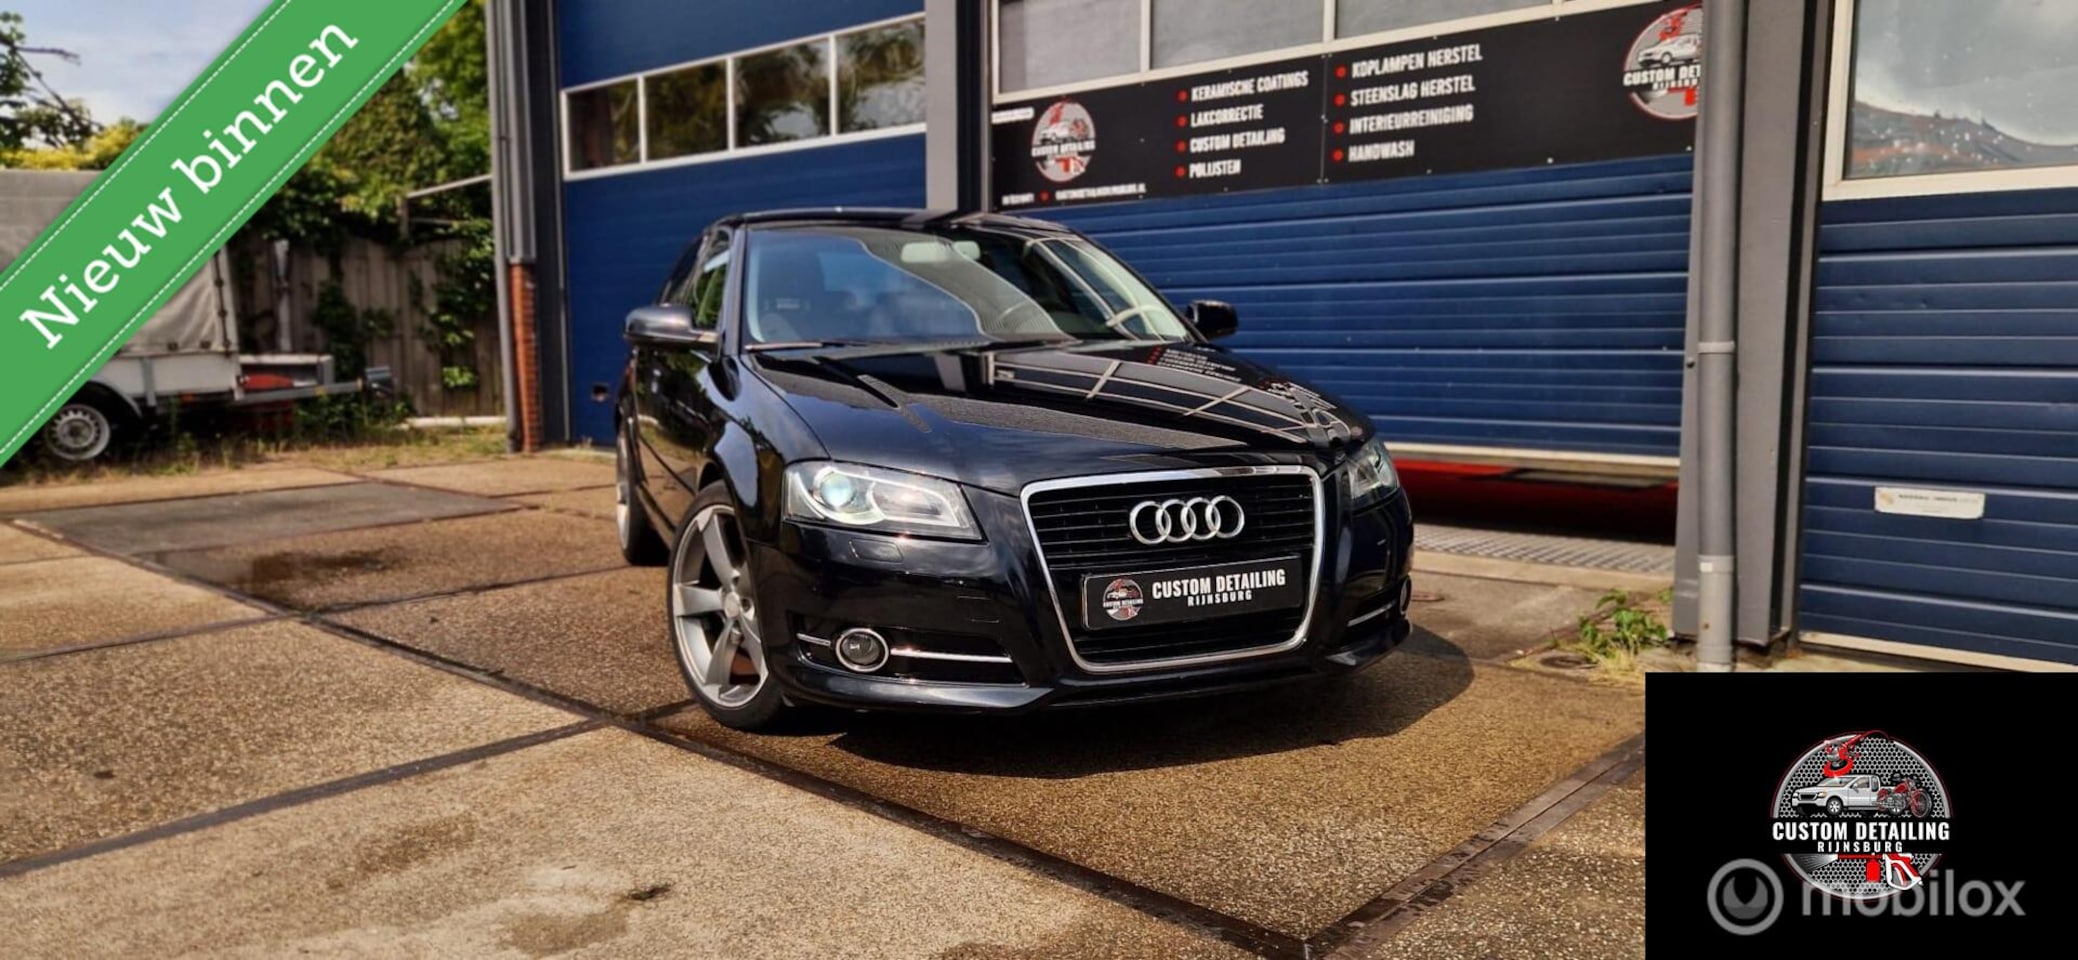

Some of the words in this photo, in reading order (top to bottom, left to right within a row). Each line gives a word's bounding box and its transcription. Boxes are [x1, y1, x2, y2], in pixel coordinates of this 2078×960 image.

[1351, 52, 1425, 78] KOPLAMPEN
[1427, 43, 1483, 68] HERSTEL
[1191, 78, 1255, 102] KERAMISCHE
[1256, 70, 1309, 92] COATINGS
[1623, 67, 1676, 87] CUSTOM
[1679, 64, 1701, 80] DET
[1350, 82, 1418, 107] STEENSLAG
[1420, 74, 1476, 98] HERSTEL
[1190, 103, 1264, 128] LAKCORRECTIE
[1349, 103, 1474, 134] INTERIEURREINIGING
[1189, 133, 1231, 153] CUSTOM
[1232, 126, 1286, 149] DETAILING
[1348, 139, 1415, 162] HANDWASH
[1189, 159, 1242, 178] POLIJSTEN
[1152, 576, 1211, 600] CUSTOM
[1215, 568, 1286, 593] DETAILING
[1187, 589, 1252, 607] RIJNSBURG
